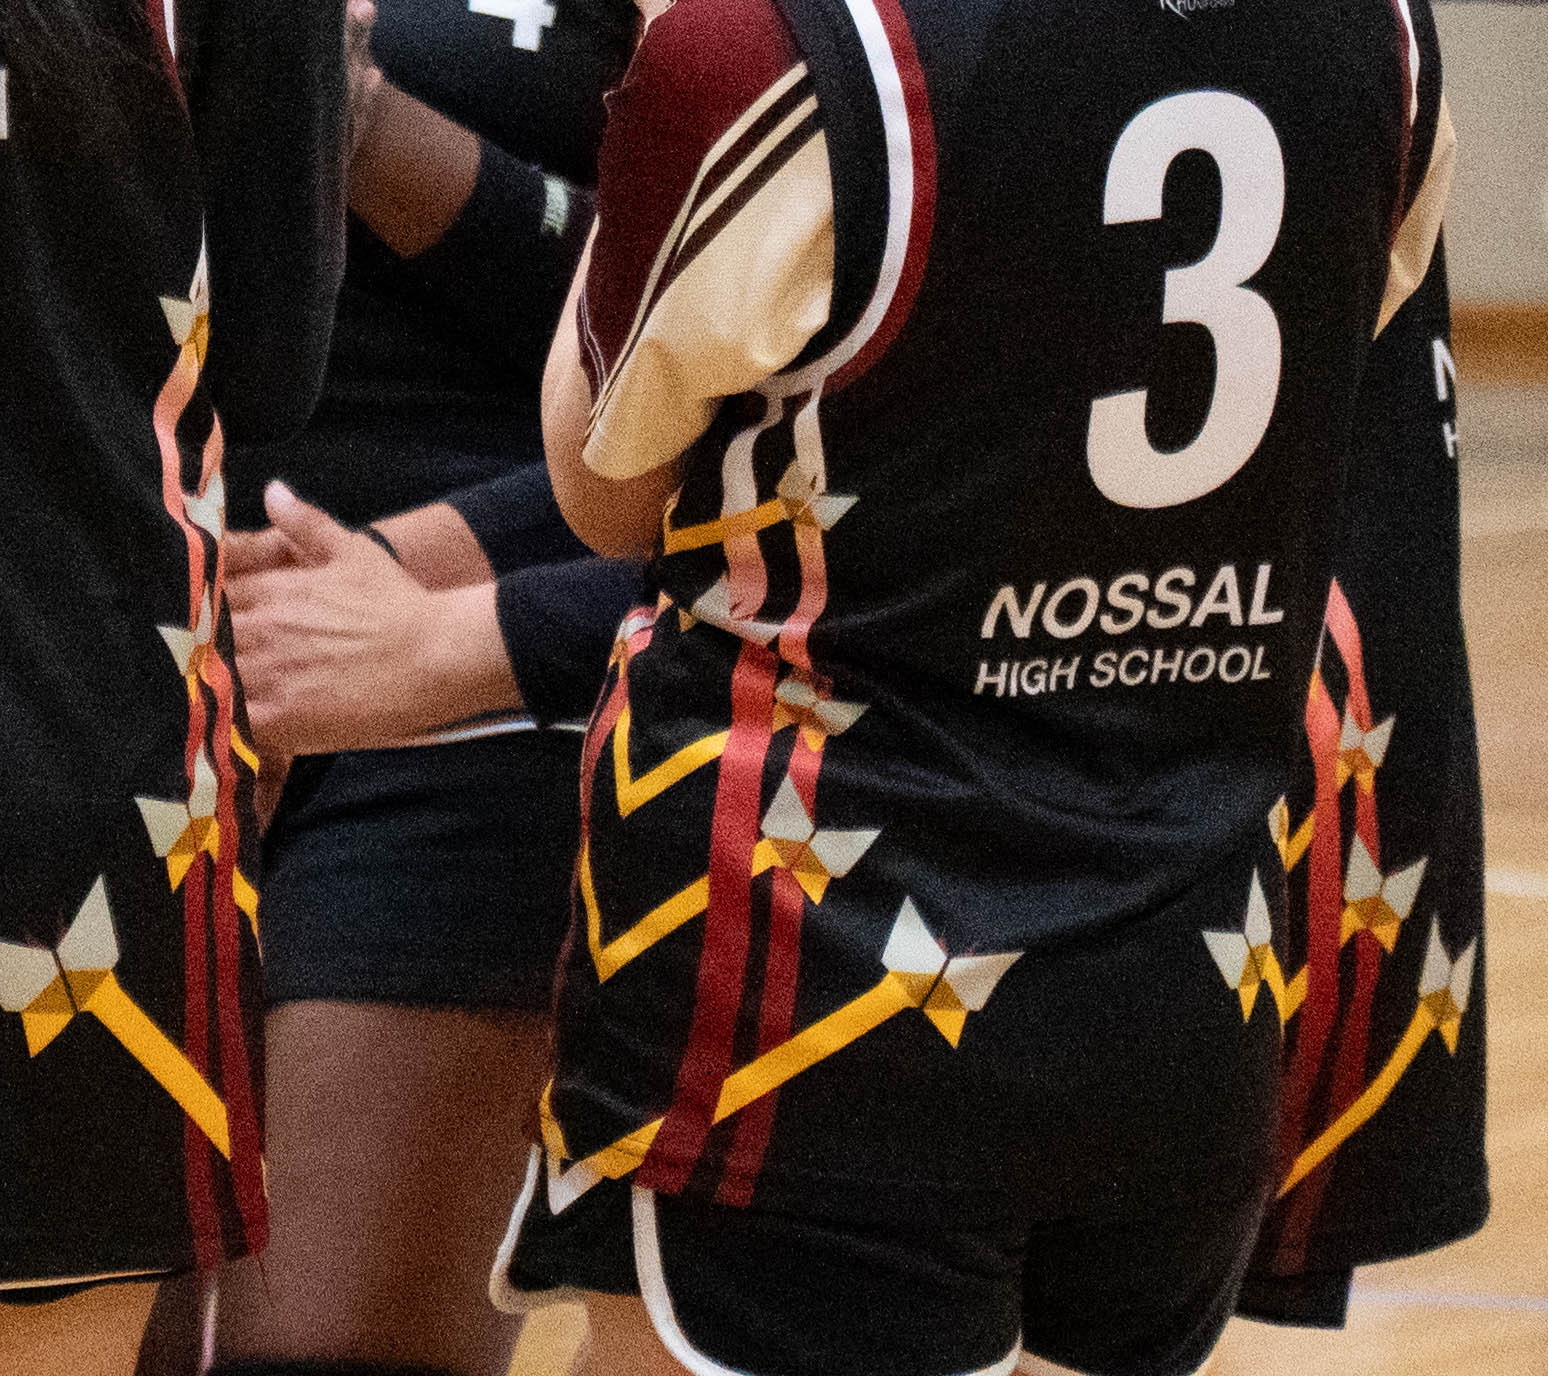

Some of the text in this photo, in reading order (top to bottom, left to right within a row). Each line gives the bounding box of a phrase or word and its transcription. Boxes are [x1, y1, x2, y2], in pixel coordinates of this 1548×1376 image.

[1087, 91, 1285, 509] 3
[981, 564, 1284, 639] NOSSAL
[973, 646, 1271, 697] HIGH SCHOOL
